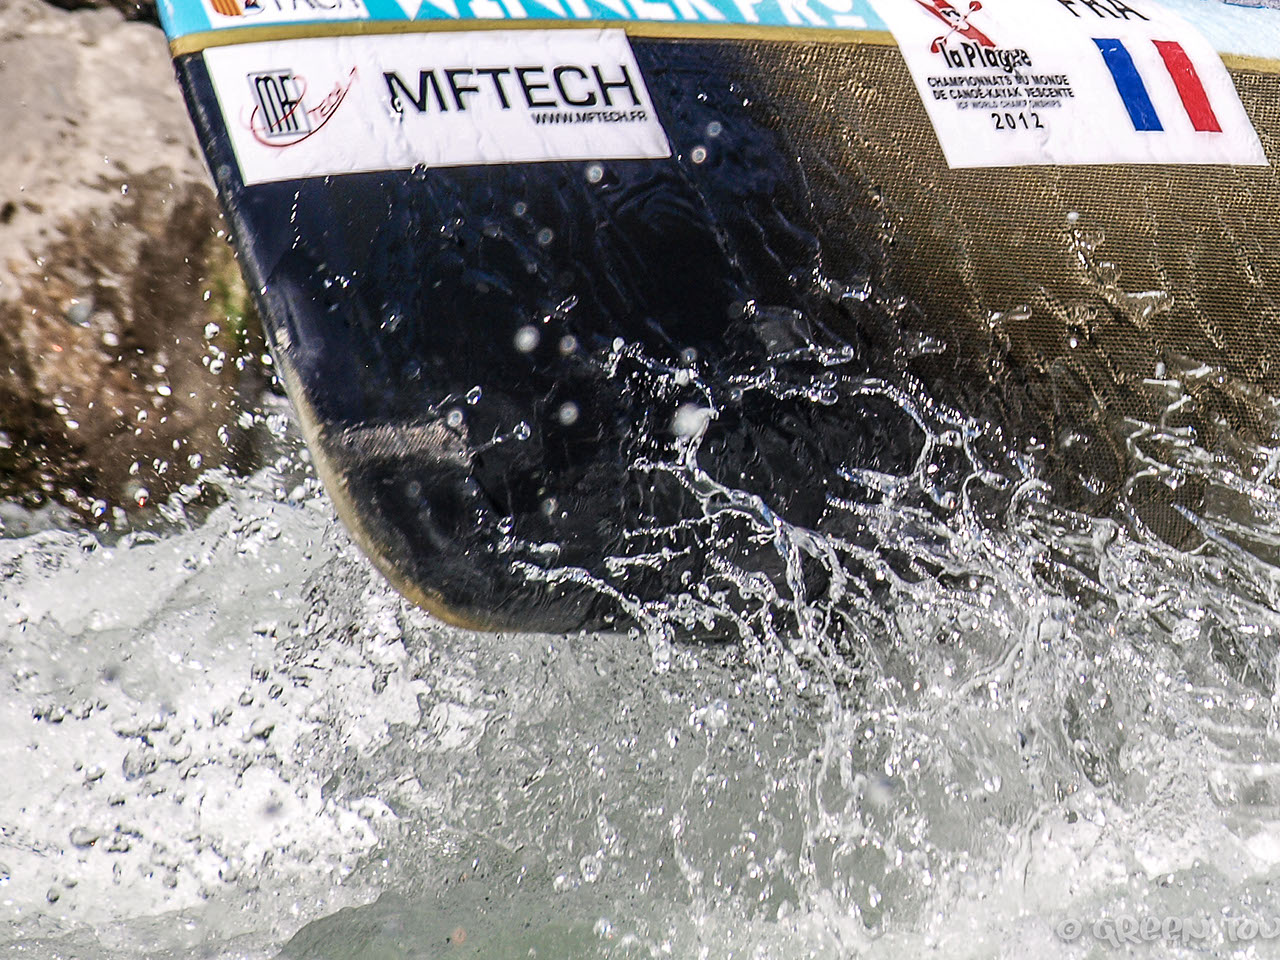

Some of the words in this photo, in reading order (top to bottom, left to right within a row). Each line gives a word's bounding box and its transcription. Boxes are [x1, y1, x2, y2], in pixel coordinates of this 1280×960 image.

[1032, 74, 1070, 86] MONDE
[383, 64, 643, 114] MFTECH
[932, 89, 948, 100] DE
[991, 112, 1045, 130] 2012
